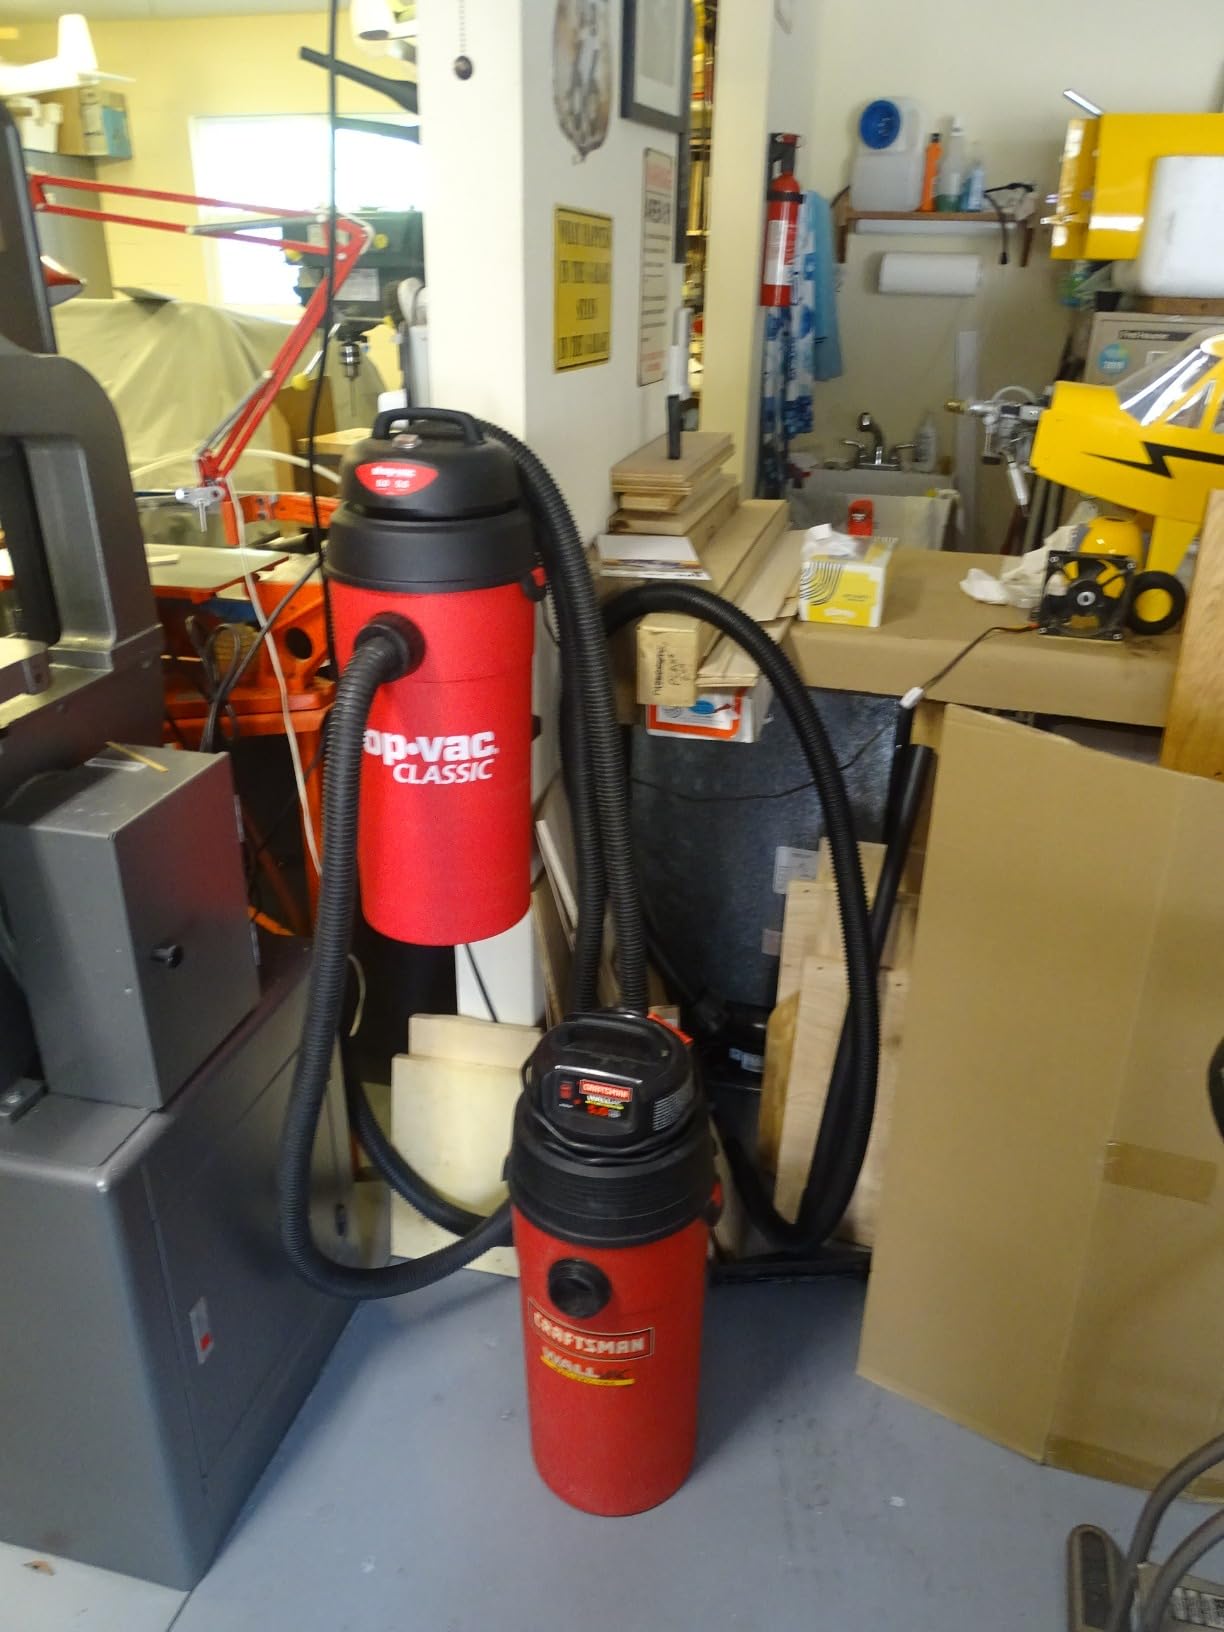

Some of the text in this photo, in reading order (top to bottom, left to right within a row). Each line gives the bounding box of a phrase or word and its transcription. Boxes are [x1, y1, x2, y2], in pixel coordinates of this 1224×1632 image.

[392, 759, 495, 785] CLASSIC
[583, 1083, 630, 1098] CRAFTSMAN
[534, 1311, 644, 1354] CRAFTSMAN
